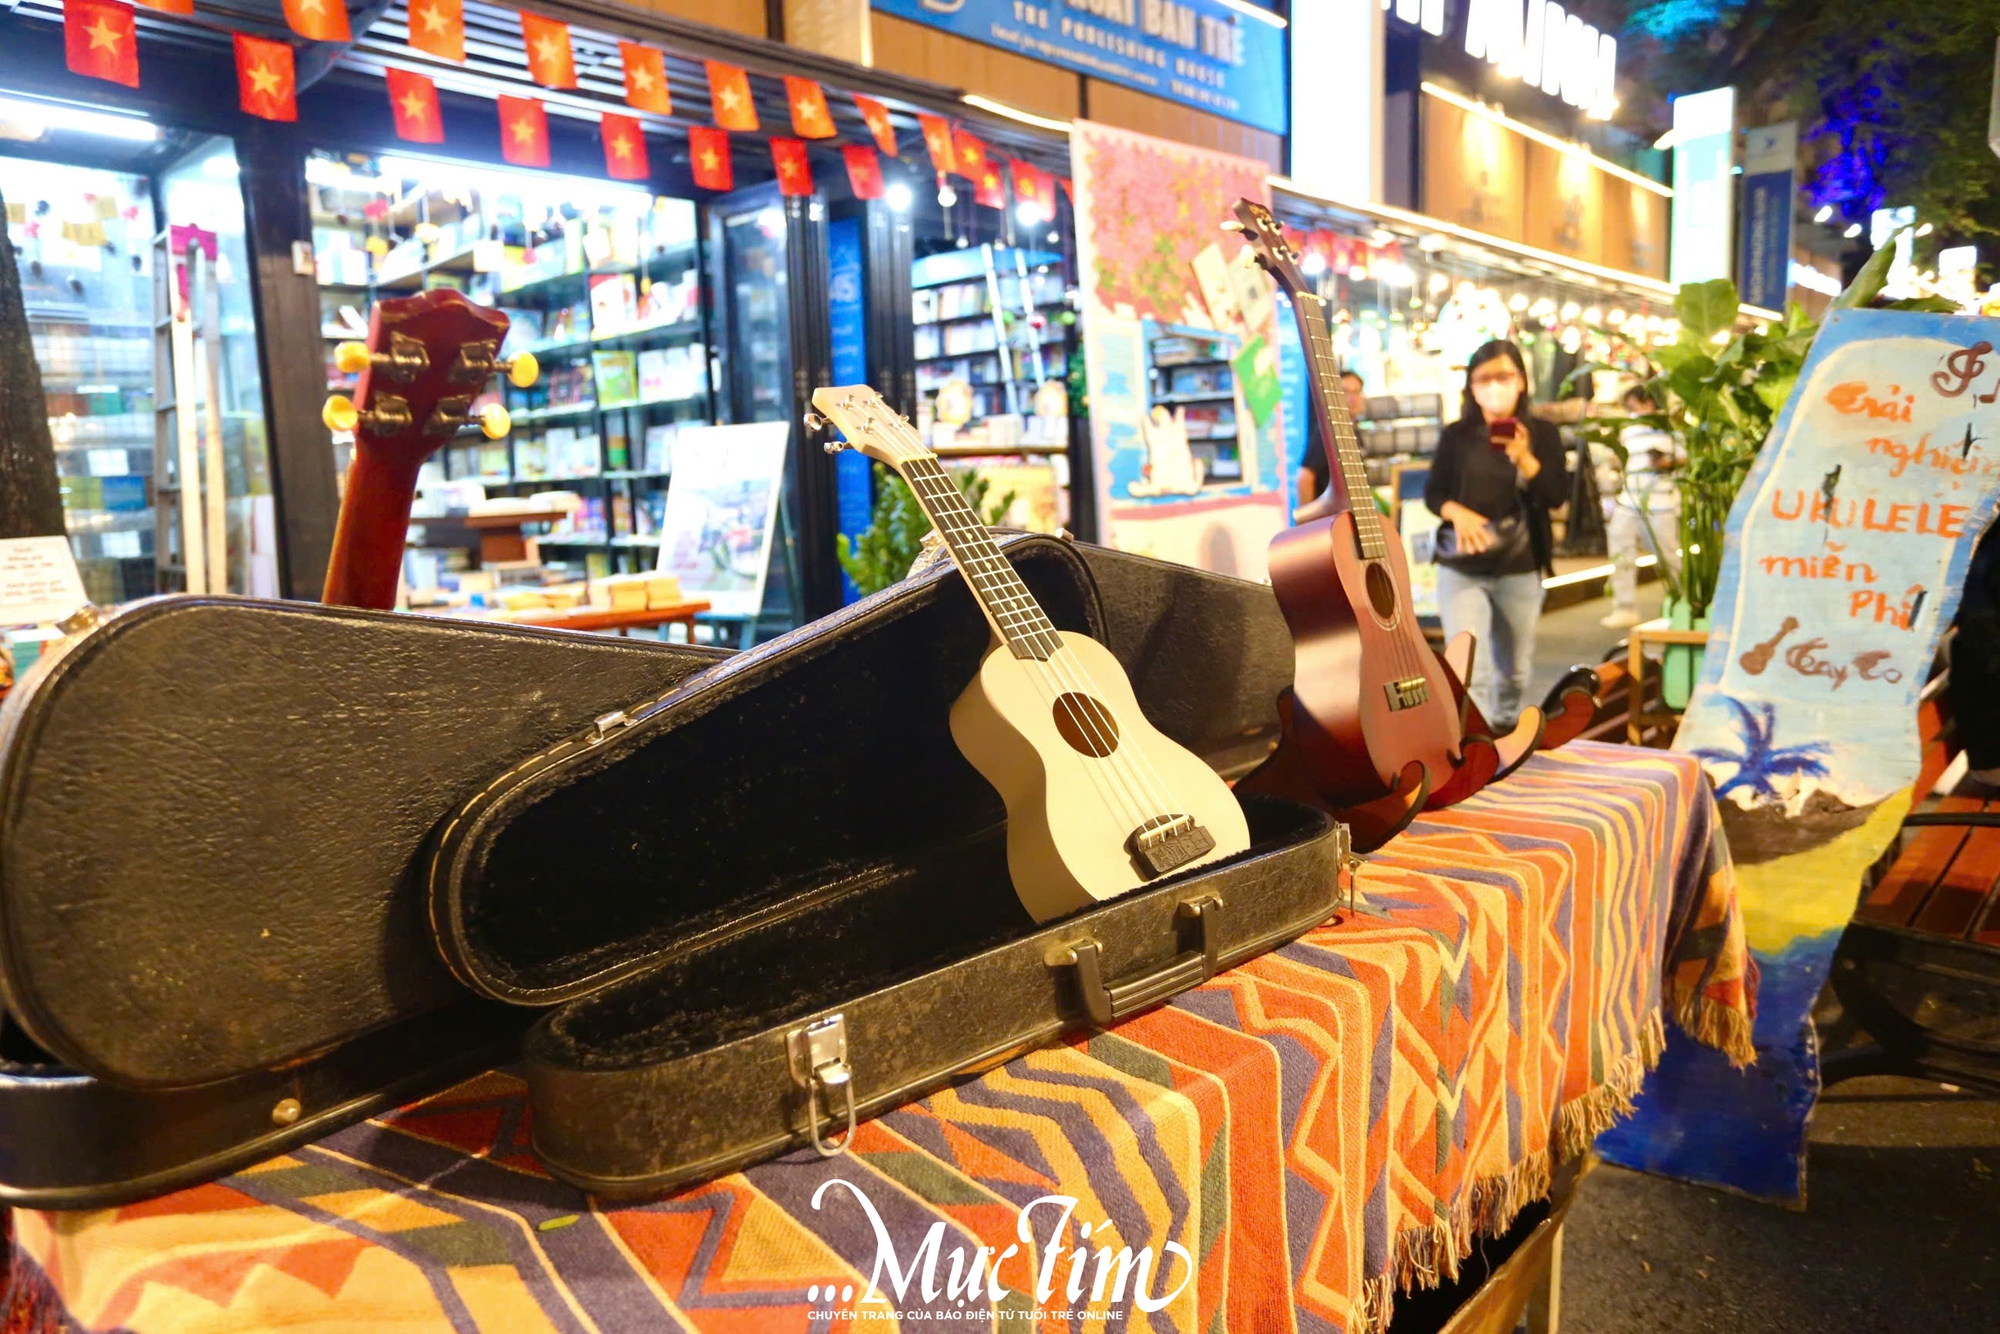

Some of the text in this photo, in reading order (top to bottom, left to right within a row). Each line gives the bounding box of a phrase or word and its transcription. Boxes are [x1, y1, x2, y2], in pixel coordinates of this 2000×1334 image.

[1060, 17, 1166, 68] PUBLISHING
[1770, 488, 1970, 538] UKULELE
[1758, 540, 1879, 583] miễn
